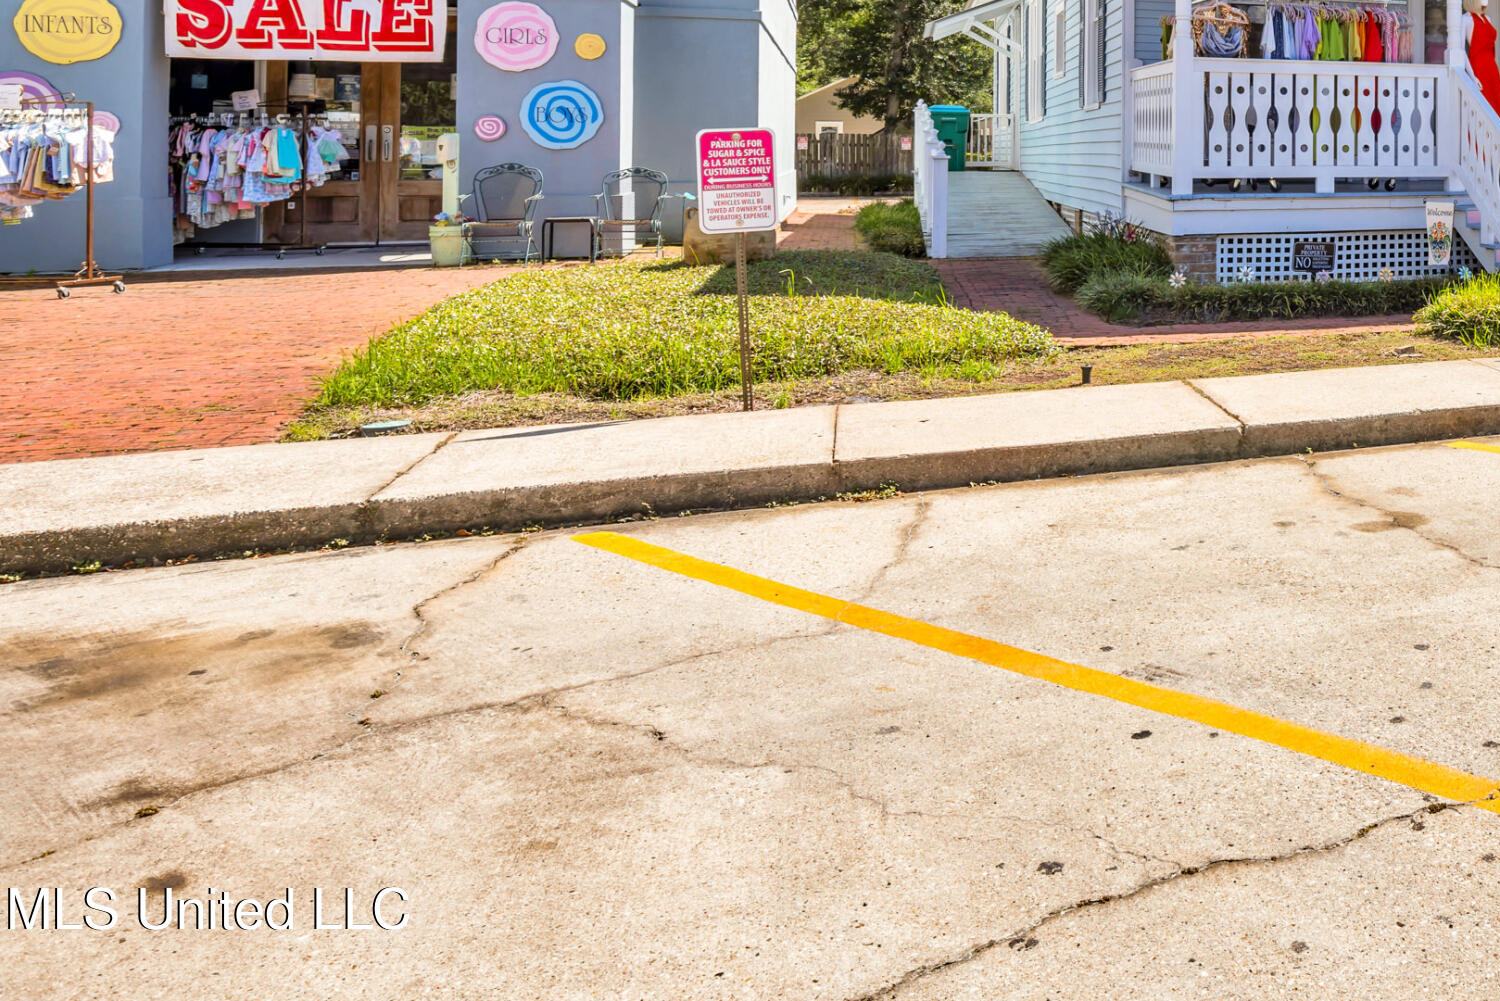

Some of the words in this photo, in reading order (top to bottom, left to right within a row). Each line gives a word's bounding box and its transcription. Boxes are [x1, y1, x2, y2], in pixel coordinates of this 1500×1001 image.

[24, 14, 113, 34] INFANTS
[485, 27, 548, 45] GIRLS
[536, 106, 588, 123] BOYS
[710, 139, 746, 149] PARKING
[747, 139, 763, 147] FOR
[708, 150, 735, 158] SUGAR
[736, 149, 743, 157] &
[743, 148, 766, 157] SPICE
[703, 159, 710, 167] &
[711, 159, 721, 167] LA
[722, 158, 747, 166] SAUCE
[748, 157, 771, 165] STYLE
[703, 167, 750, 176] CUSTOMERS
[751, 166, 771, 174] ONLY
[716, 191, 761, 199] UNAUTHORIZED
[1427, 207, 1453, 216] Welcome
[1295, 256, 1311, 268] NO
